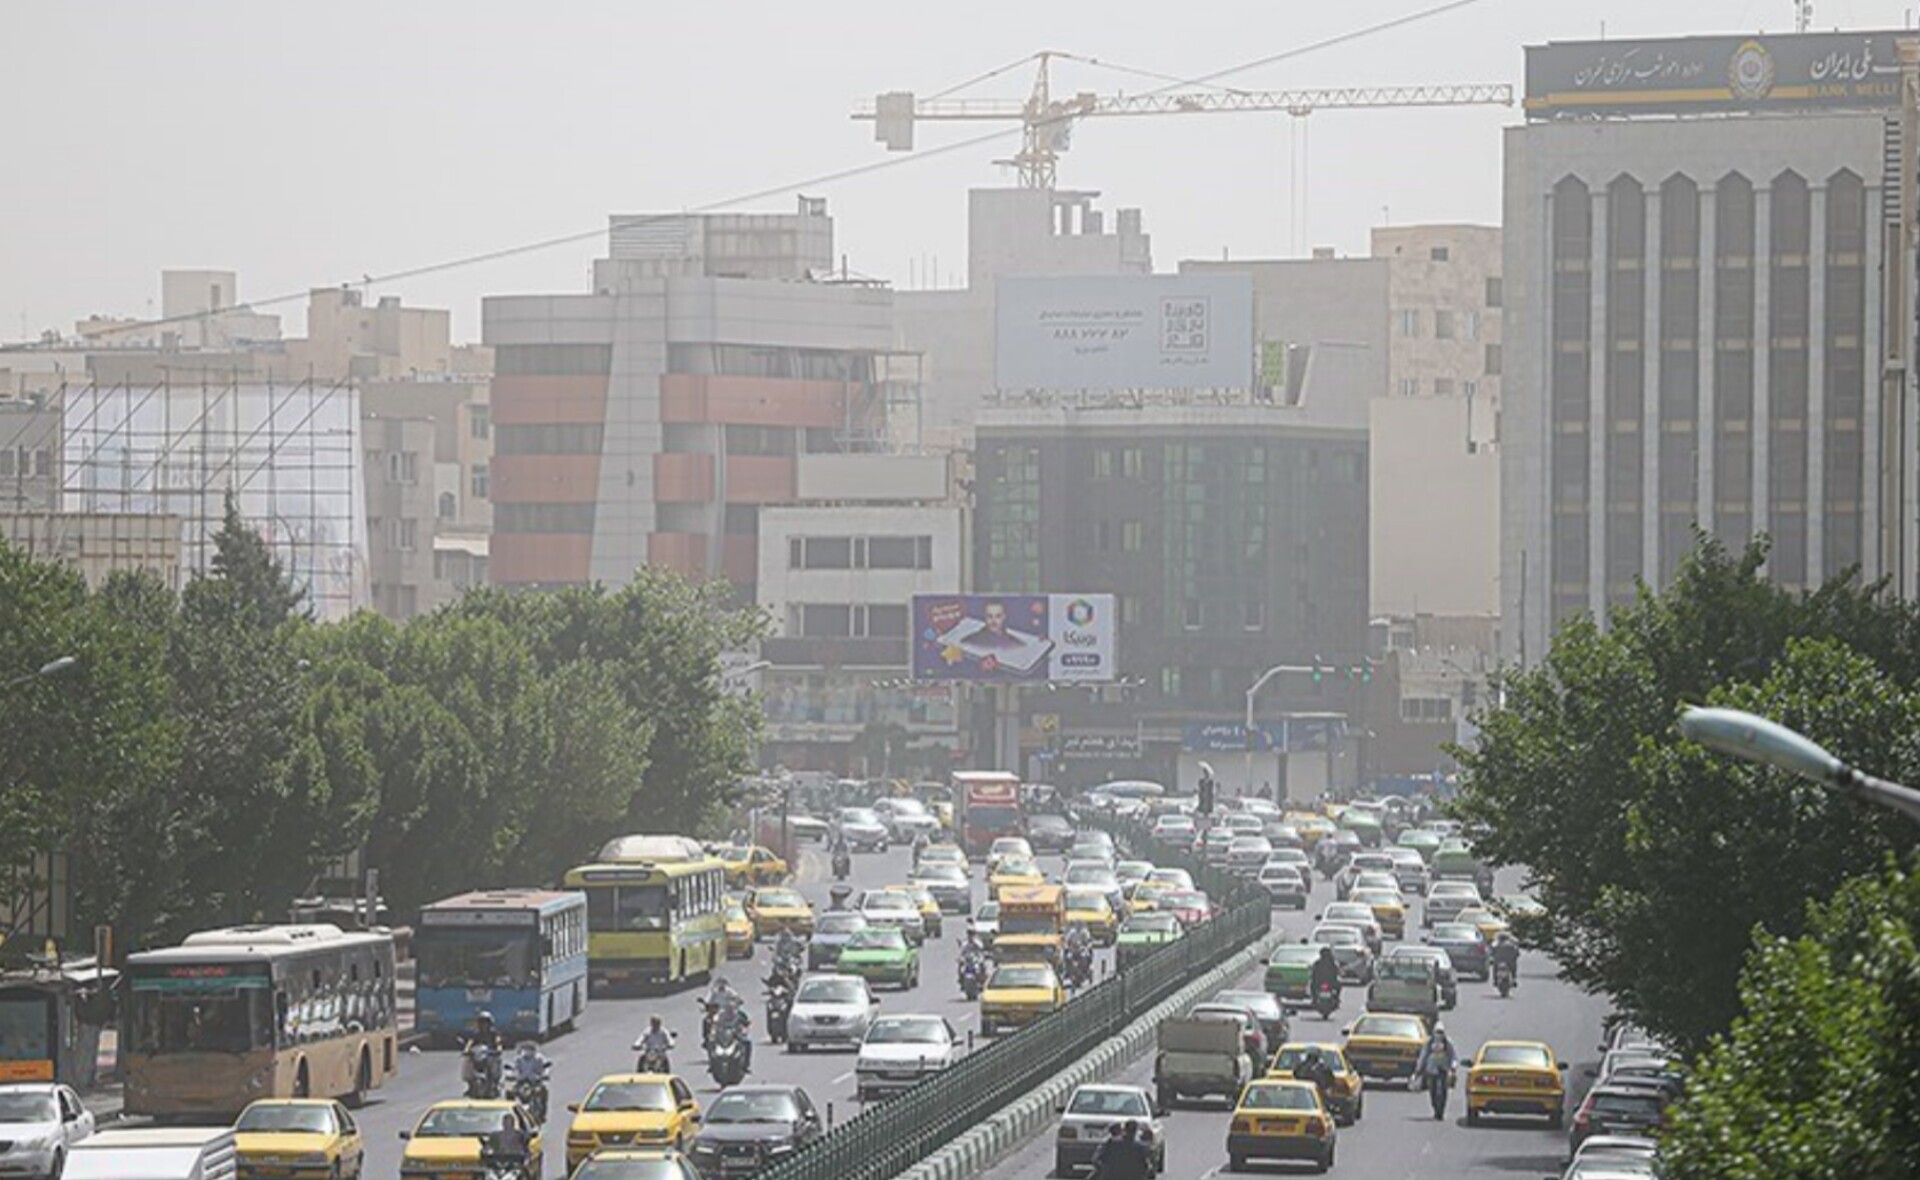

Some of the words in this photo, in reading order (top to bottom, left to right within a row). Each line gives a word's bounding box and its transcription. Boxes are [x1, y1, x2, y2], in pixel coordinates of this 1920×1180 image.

[1574, 56, 1606, 86] تهران
[1810, 51, 1851, 80] ایران
[1809, 82, 1849, 97] BANK
[1855, 81, 1897, 96] MELLI
